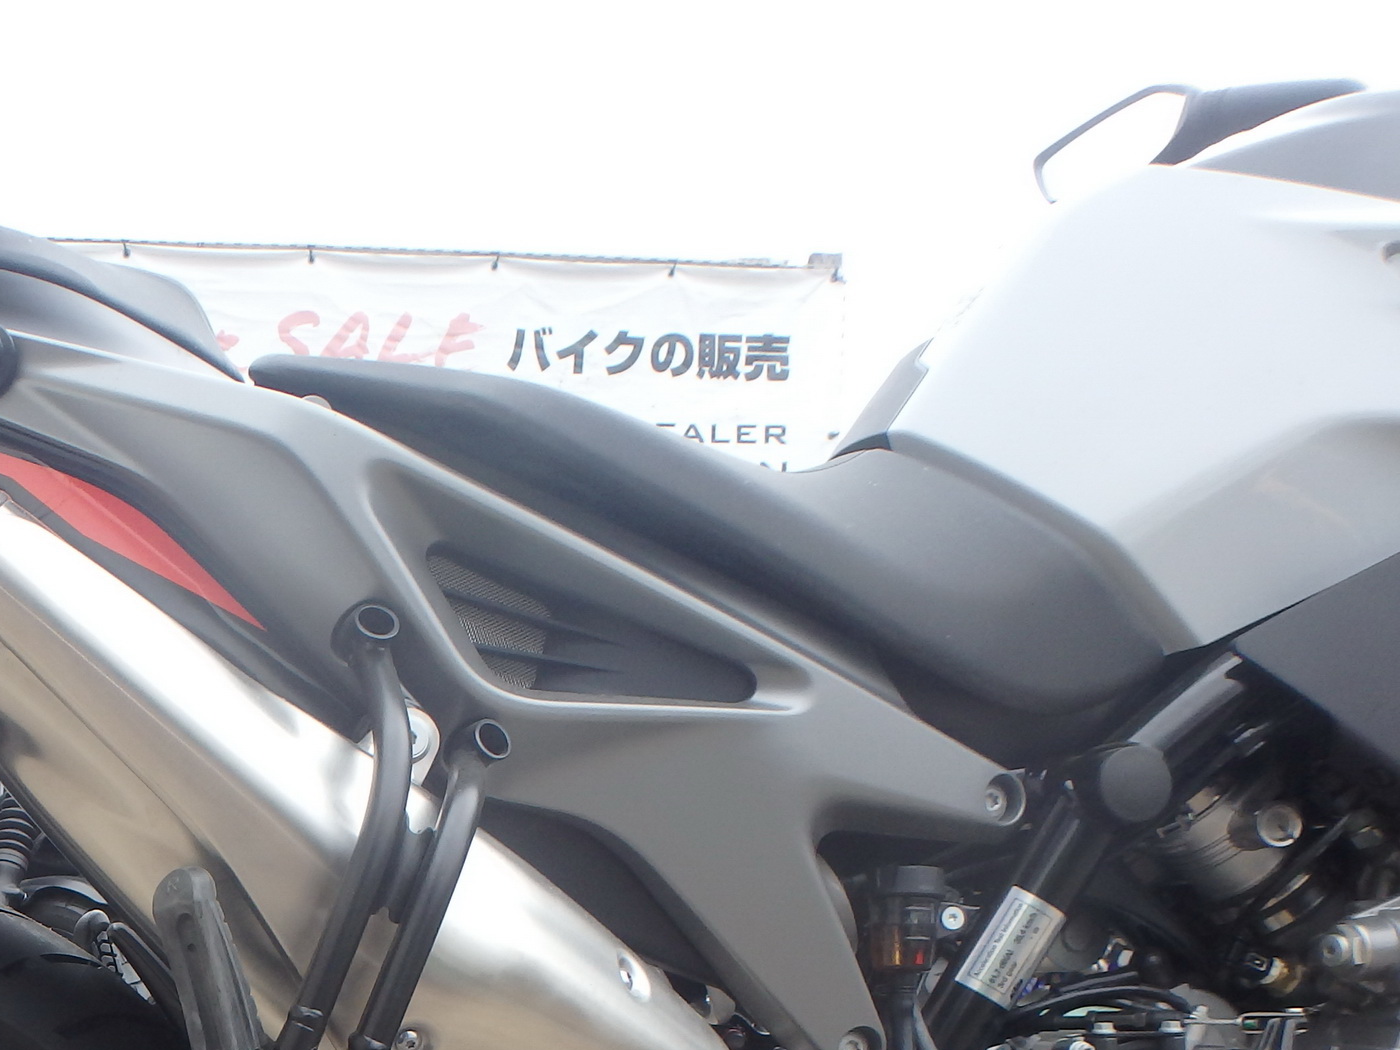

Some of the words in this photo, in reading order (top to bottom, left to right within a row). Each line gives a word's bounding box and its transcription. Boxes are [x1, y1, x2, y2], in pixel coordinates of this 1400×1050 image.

[507, 327, 791, 381] バイクの販売
[656, 423, 788, 445] ALER
